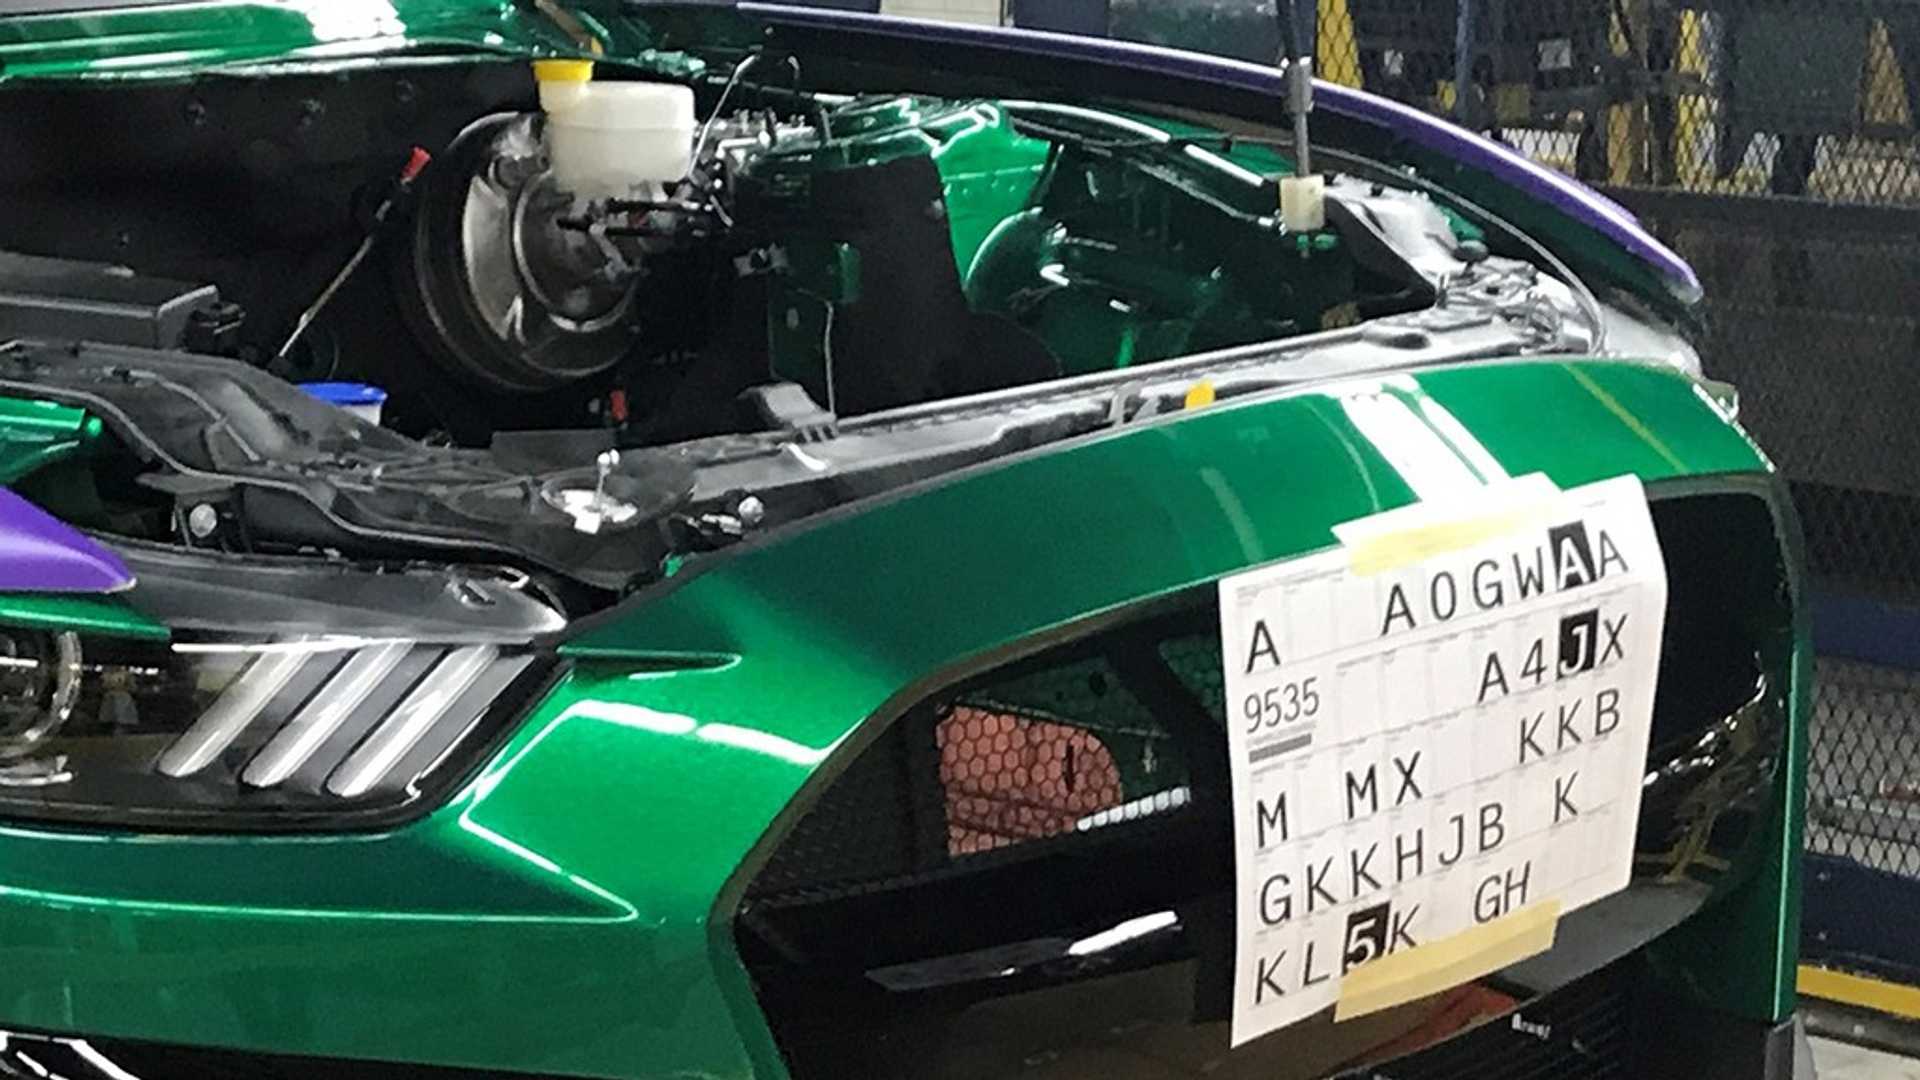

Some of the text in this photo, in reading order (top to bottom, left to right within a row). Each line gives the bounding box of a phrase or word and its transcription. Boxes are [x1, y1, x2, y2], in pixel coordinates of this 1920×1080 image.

[1245, 620, 1281, 674] A
[1244, 677, 1320, 735] 9535
[1256, 690, 1621, 849] M MX KKB
[1553, 772, 1580, 824] K
[1473, 862, 1532, 925] GH
